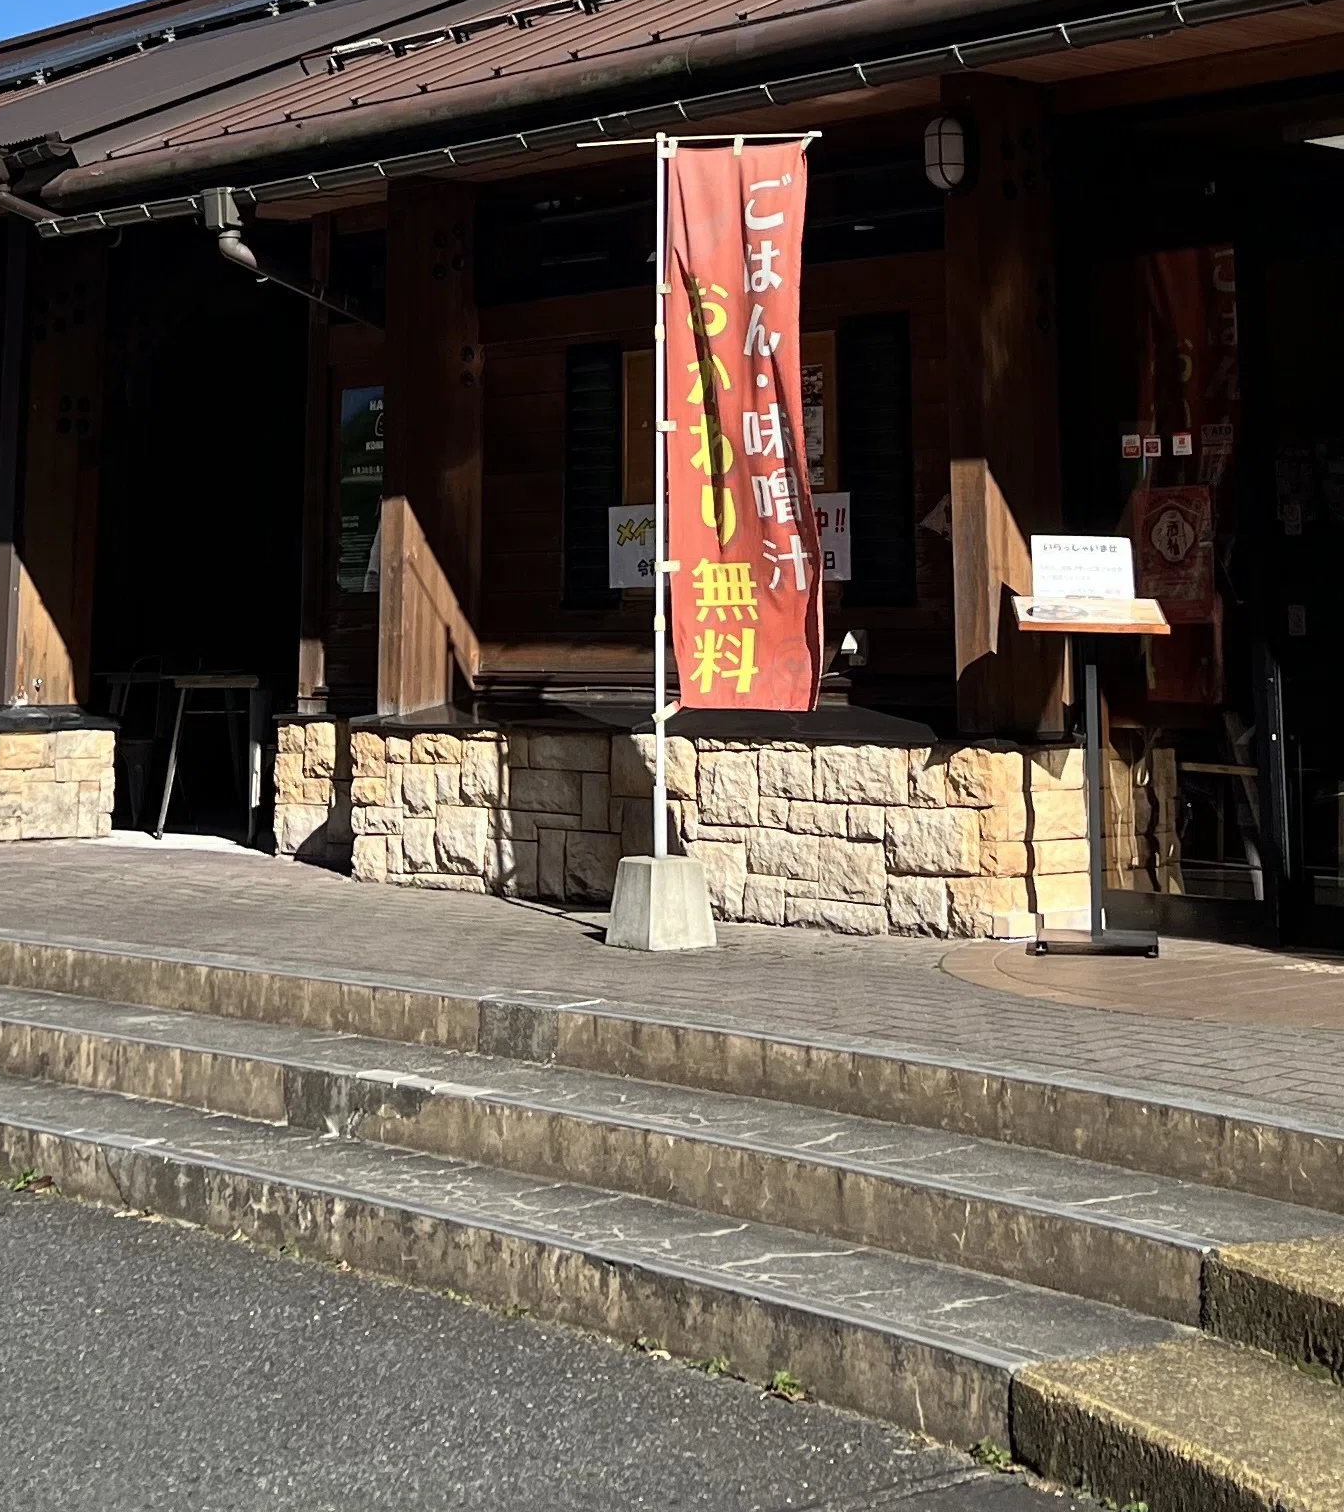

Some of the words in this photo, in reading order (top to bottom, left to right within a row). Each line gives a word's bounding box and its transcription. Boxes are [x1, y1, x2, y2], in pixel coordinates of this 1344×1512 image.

[1043, 543, 1118, 554] いらっしゃいませ
